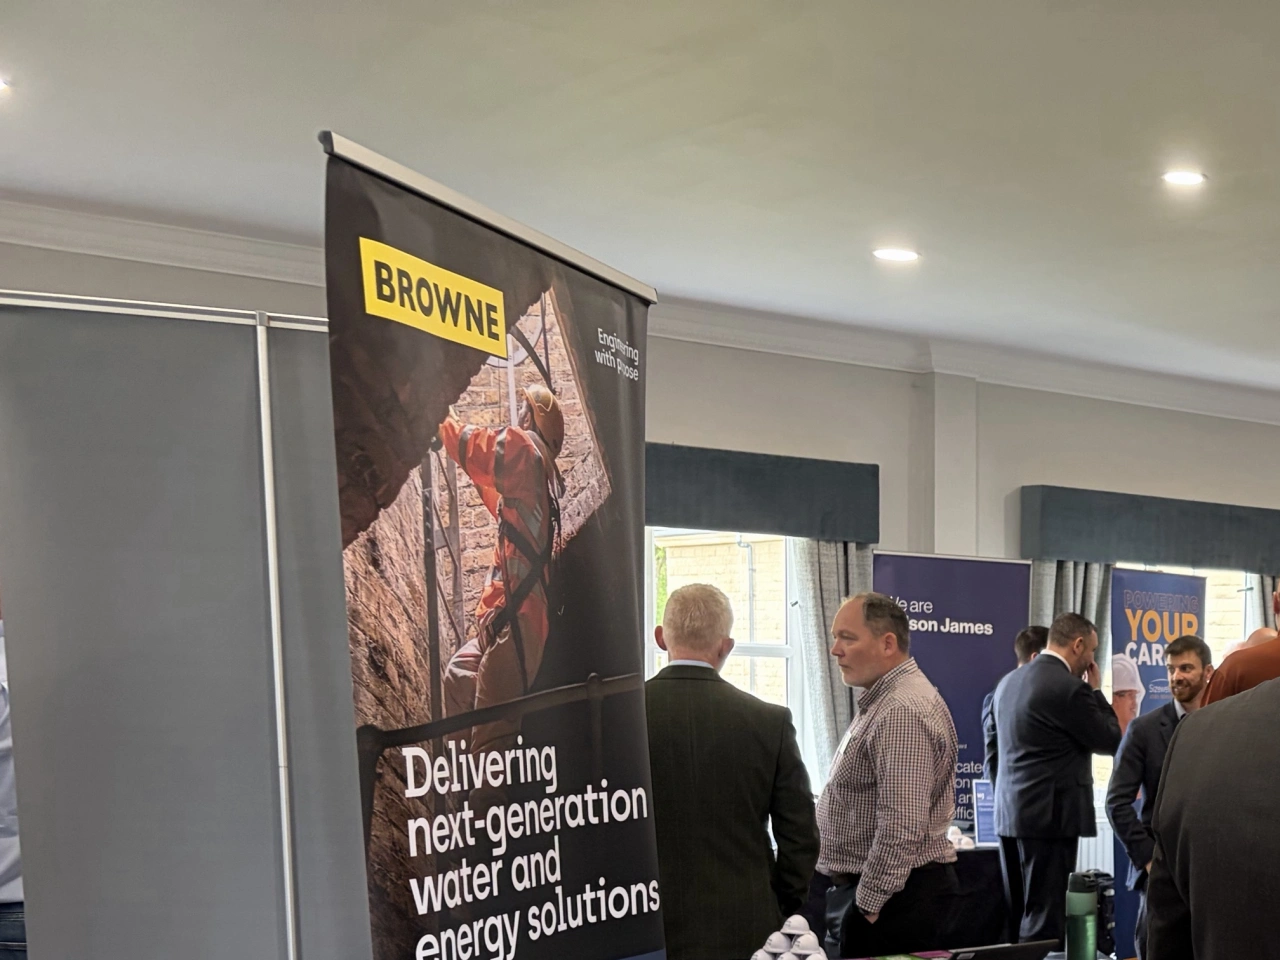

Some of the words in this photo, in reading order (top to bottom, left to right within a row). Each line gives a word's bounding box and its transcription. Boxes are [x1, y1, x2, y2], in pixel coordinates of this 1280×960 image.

[373, 260, 500, 341] BROWNE
[594, 348, 616, 368] with
[909, 600, 934, 614] are
[1123, 590, 1199, 613] POWERING
[907, 615, 938, 632] son
[940, 617, 994, 635] James
[1125, 608, 1198, 642] YOUR
[401, 734, 557, 798] Delivering
[954, 761, 984, 773] cate
[957, 794, 974, 805] an
[407, 778, 648, 857] next-generation
[409, 856, 503, 915] water
[511, 835, 561, 891] and
[527, 877, 661, 941] solutions
